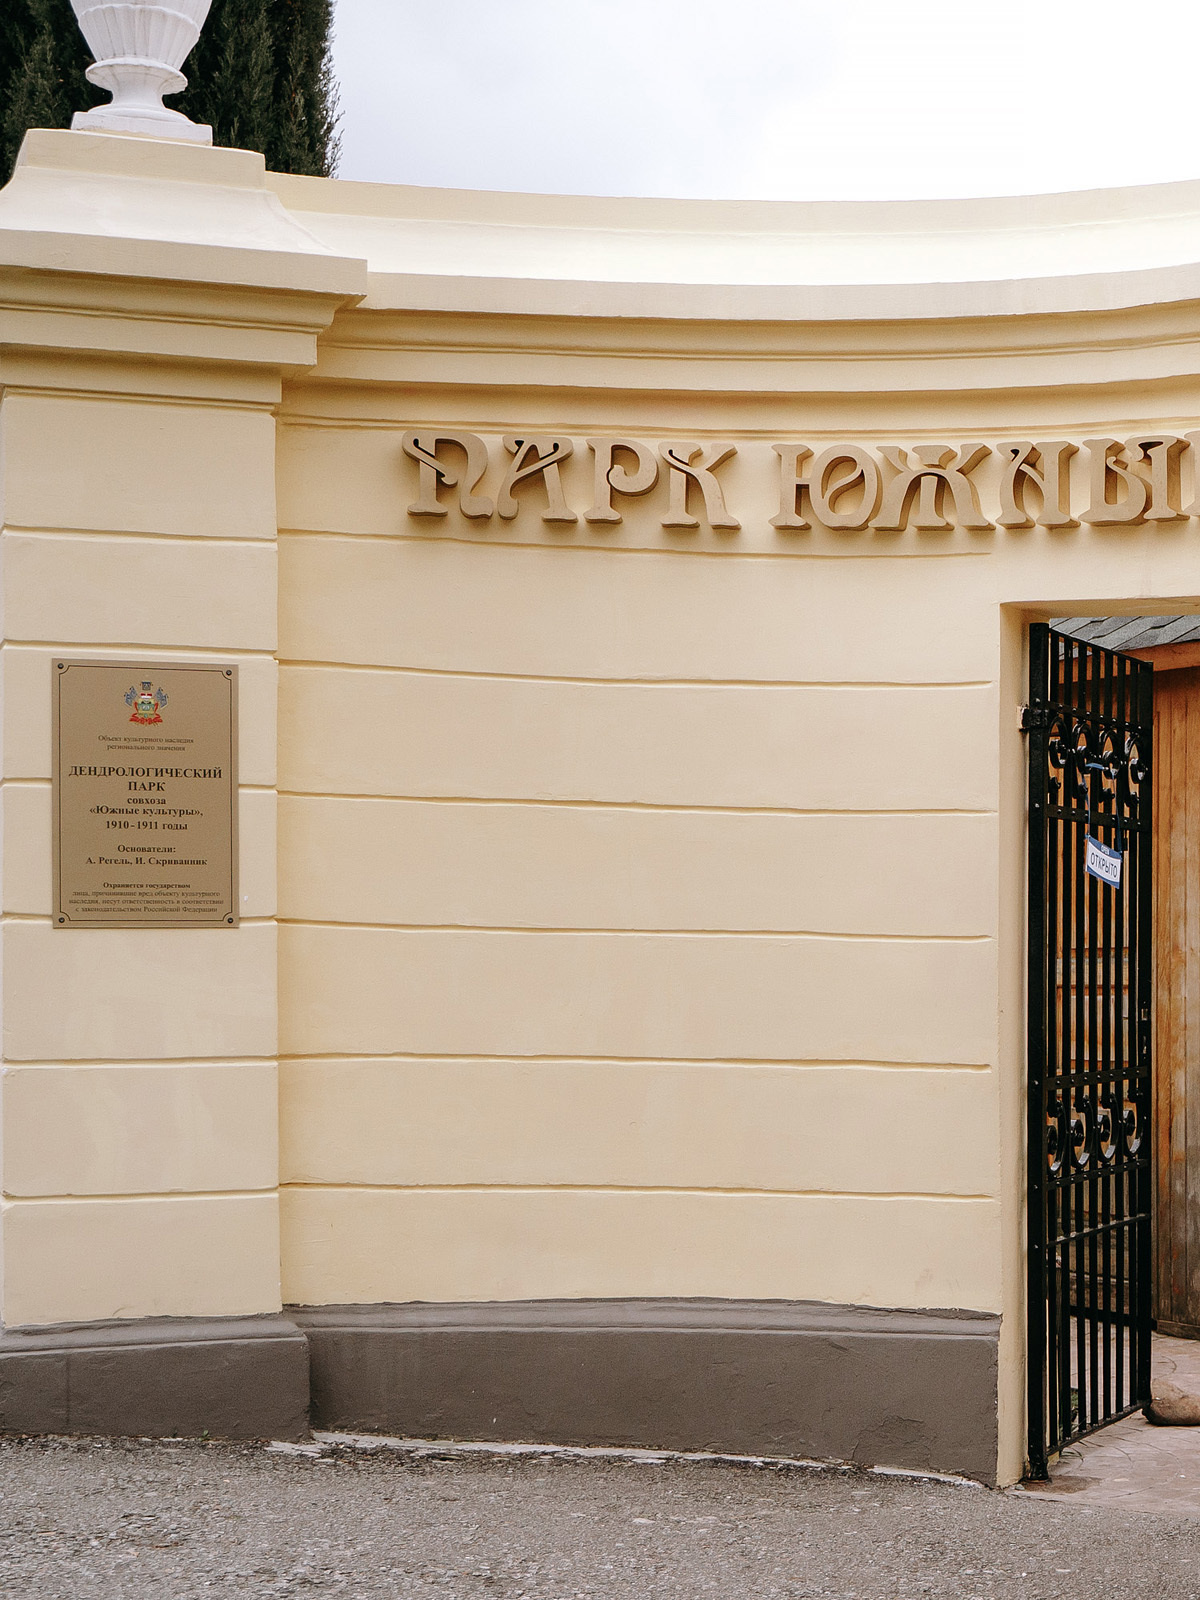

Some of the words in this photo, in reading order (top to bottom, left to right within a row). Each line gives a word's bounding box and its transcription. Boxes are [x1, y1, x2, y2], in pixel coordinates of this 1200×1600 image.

[402, 430, 742, 531] ПАРК
[68, 766, 222, 779] ДЕНДРОЛОГИЧЕСКИЙ
[127, 781, 166, 792] ПАРК
[127, 797, 167, 805] совхоза
[89, 805, 140, 815] «Южные
[142, 808, 203, 818] культуры»,
[162, 823, 188, 831] годы
[117, 844, 177, 853] Основатели:
[86, 857, 96, 865] А.
[98, 857, 133, 866] Регель,
[135, 857, 146, 865] И.
[1090, 853, 1118, 877] ОТКРЫТО
